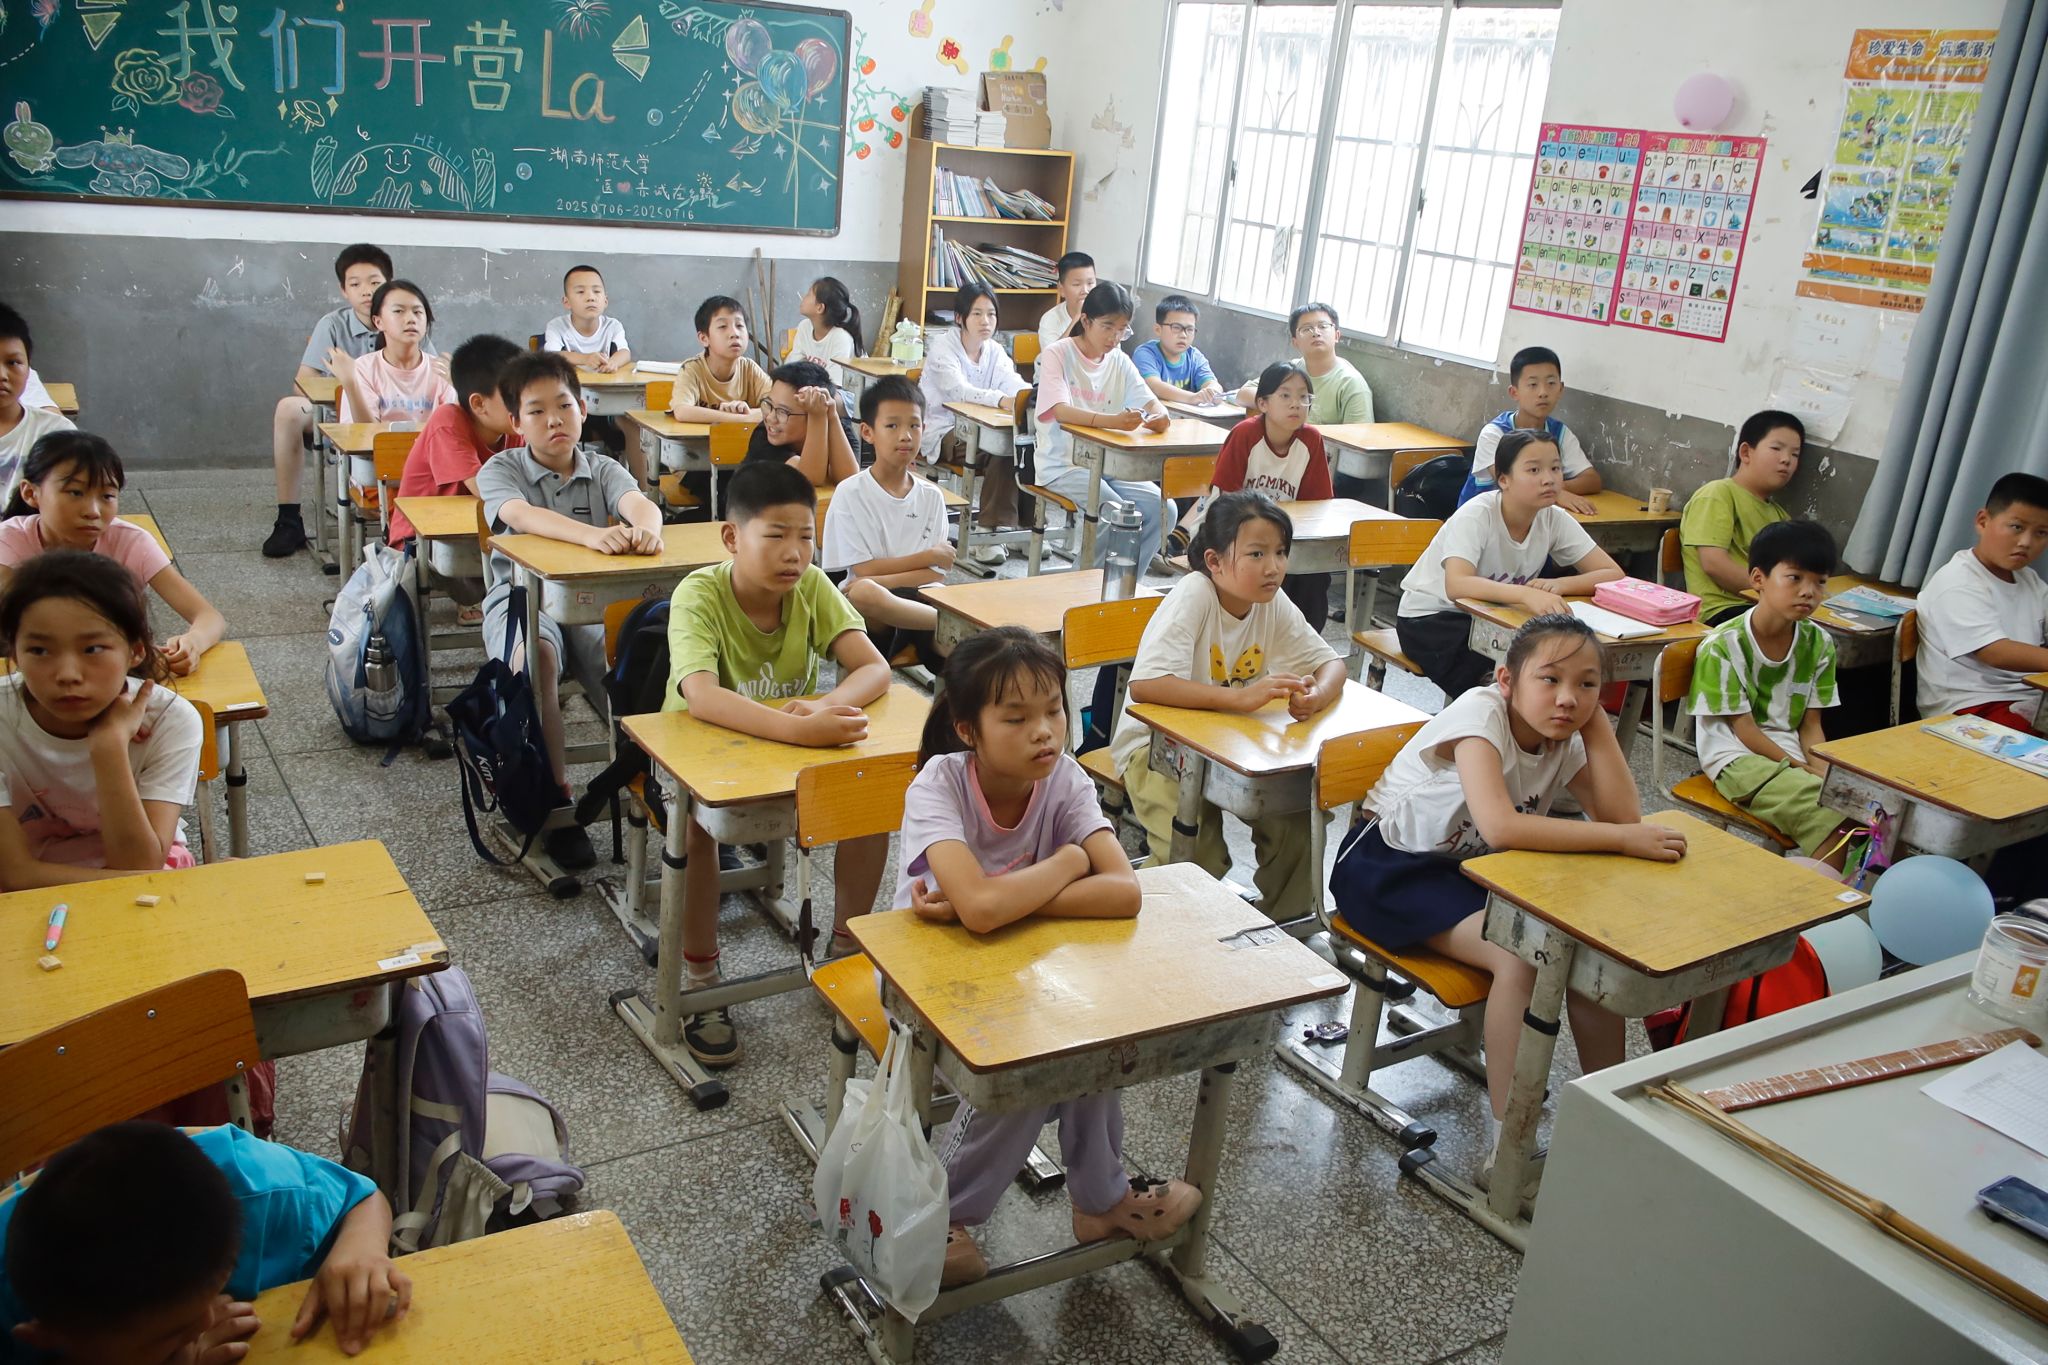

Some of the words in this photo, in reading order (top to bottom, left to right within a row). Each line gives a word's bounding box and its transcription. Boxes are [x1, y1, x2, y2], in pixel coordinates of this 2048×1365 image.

[1868, 40, 1925, 57] 珍爱生命
[549, 147, 650, 176] 湖南师范大学
[1559, 147, 1567, 157] o
[1579, 148, 1586, 159] e
[1686, 158, 1697, 171] m
[1733, 161, 1742, 174] d
[1659, 191, 1667, 204] n
[1704, 196, 1712, 208] g
[1726, 197, 1734, 211] k
